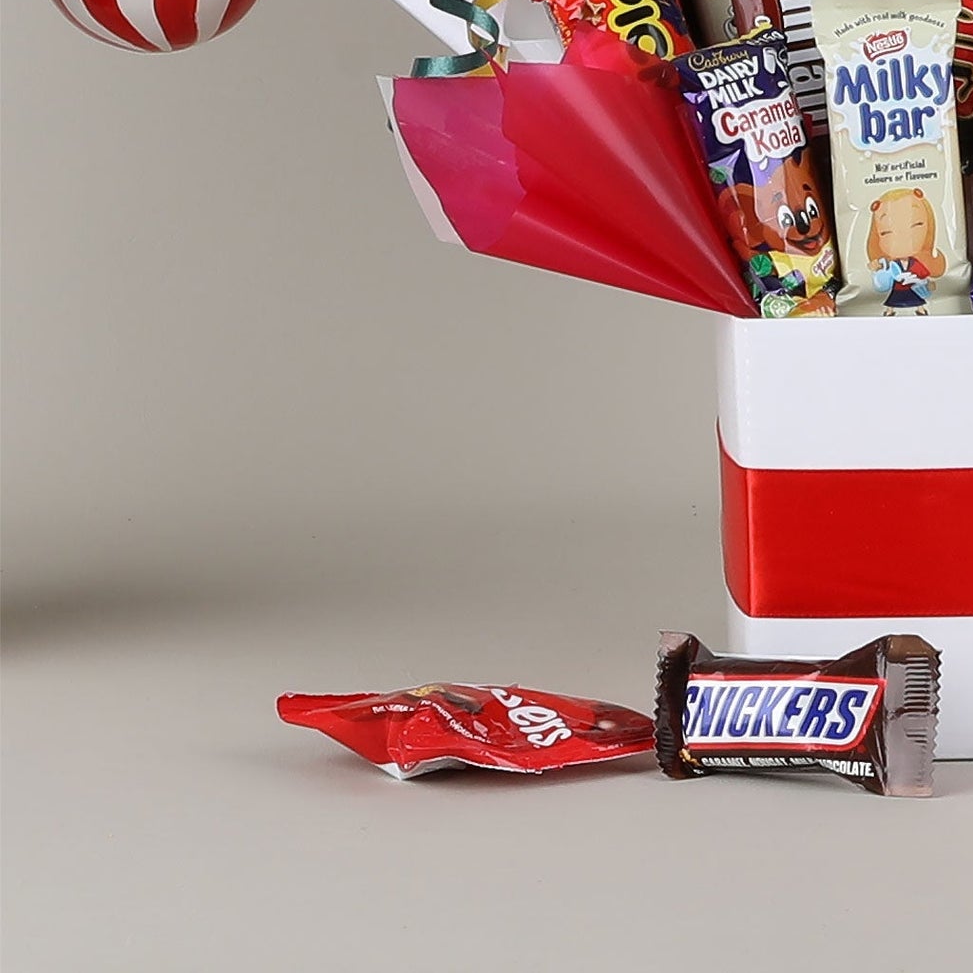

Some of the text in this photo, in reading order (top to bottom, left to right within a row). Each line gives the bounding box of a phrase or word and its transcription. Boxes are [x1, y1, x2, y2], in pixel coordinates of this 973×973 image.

[854, 14, 871, 26] with
[891, 11, 907, 19] milk
[688, 50, 748, 72] Cadbury
[697, 56, 759, 89] DAIRY
[708, 77, 764, 110] MILK
[834, 54, 953, 106] Milky
[750, 121, 802, 155] Koala
[859, 102, 936, 144] bar
[683, 685, 868, 740] SNICKERS
